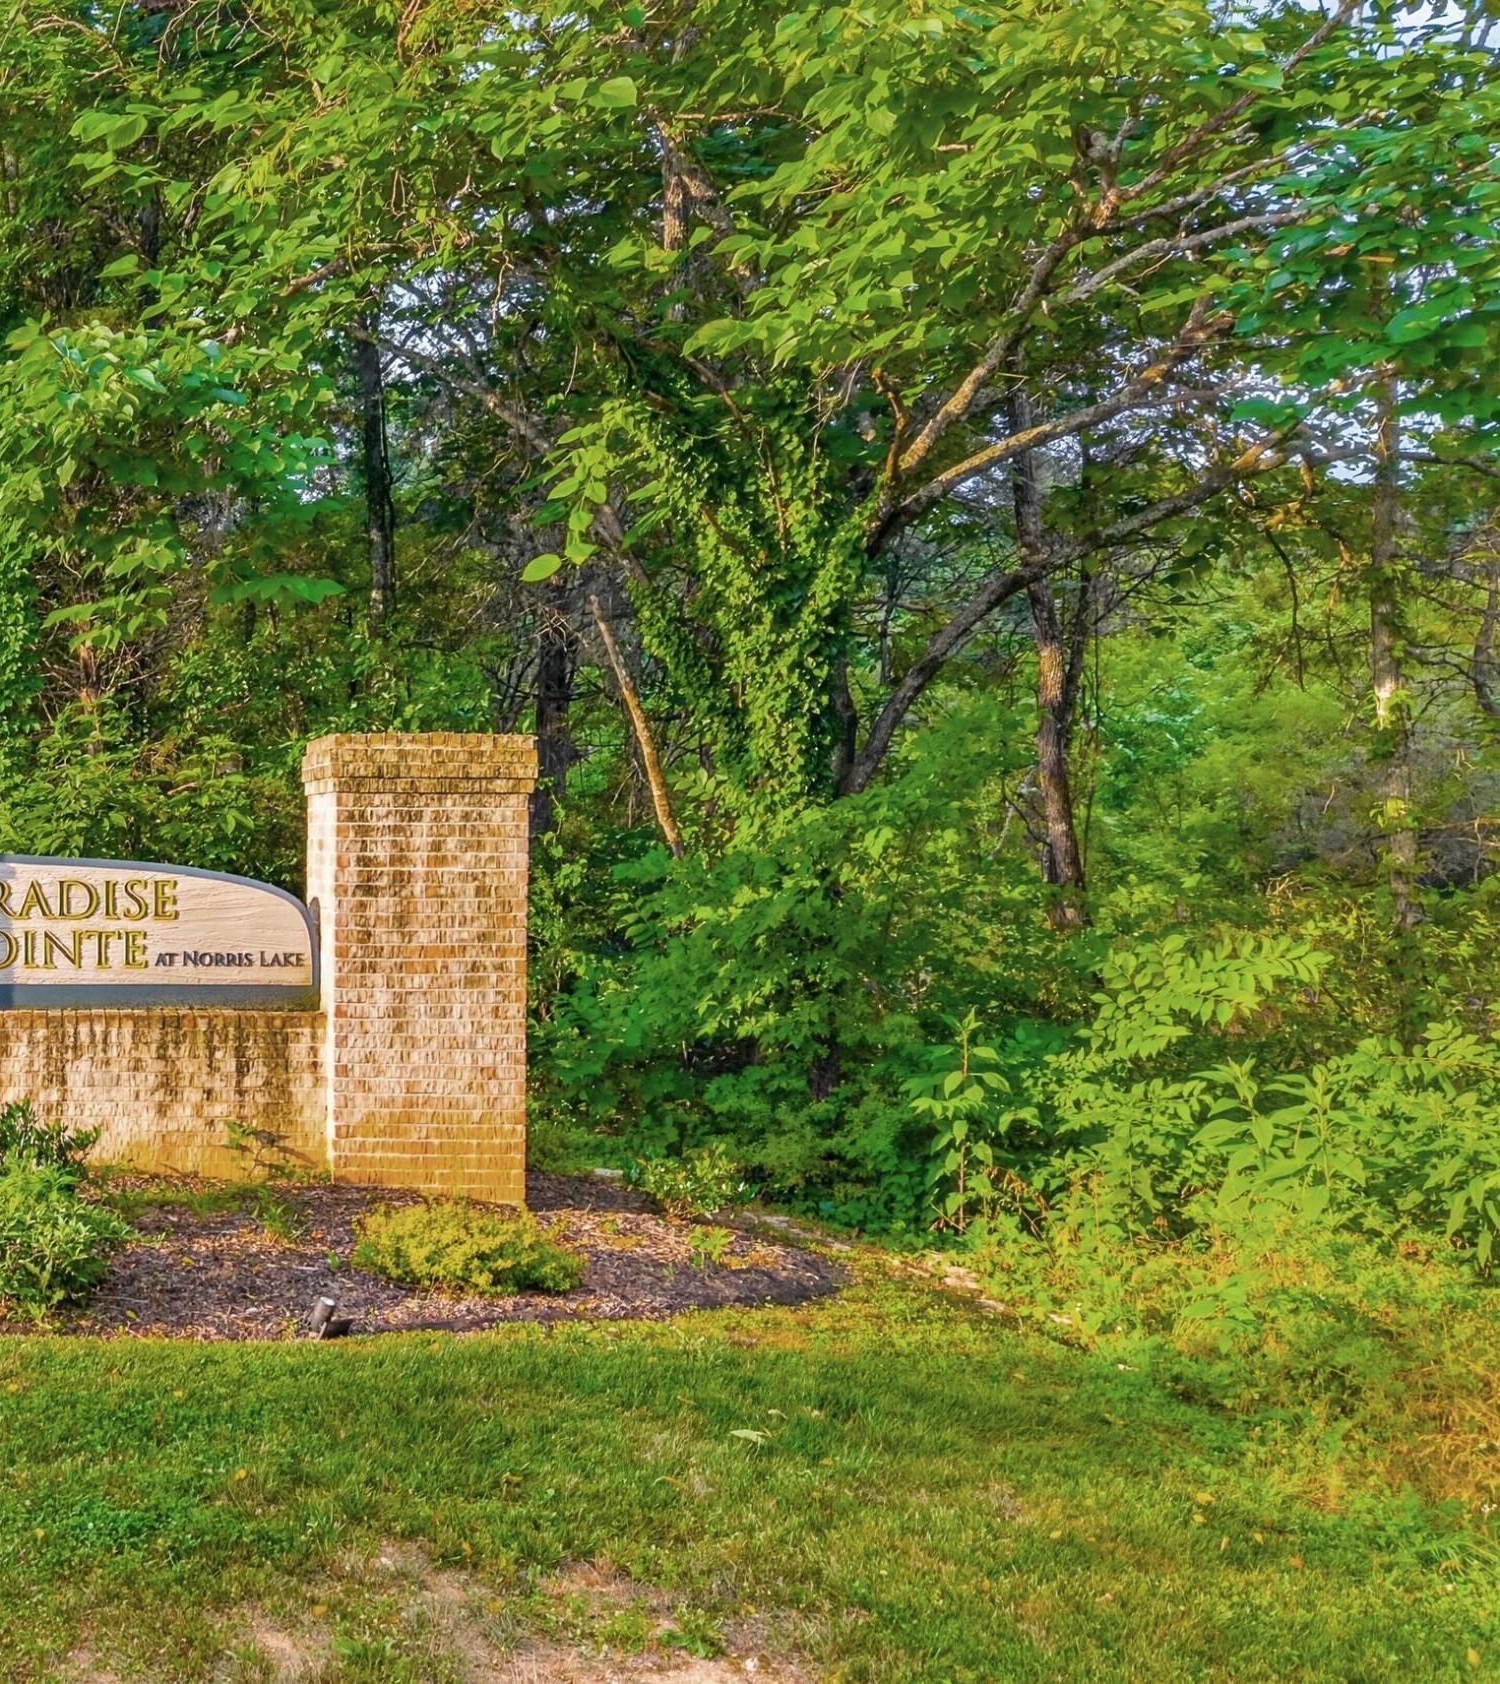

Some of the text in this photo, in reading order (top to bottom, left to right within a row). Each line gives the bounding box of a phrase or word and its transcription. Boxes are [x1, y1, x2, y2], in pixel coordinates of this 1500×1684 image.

[154, 950, 306, 968] AT NORRIS LAKE
